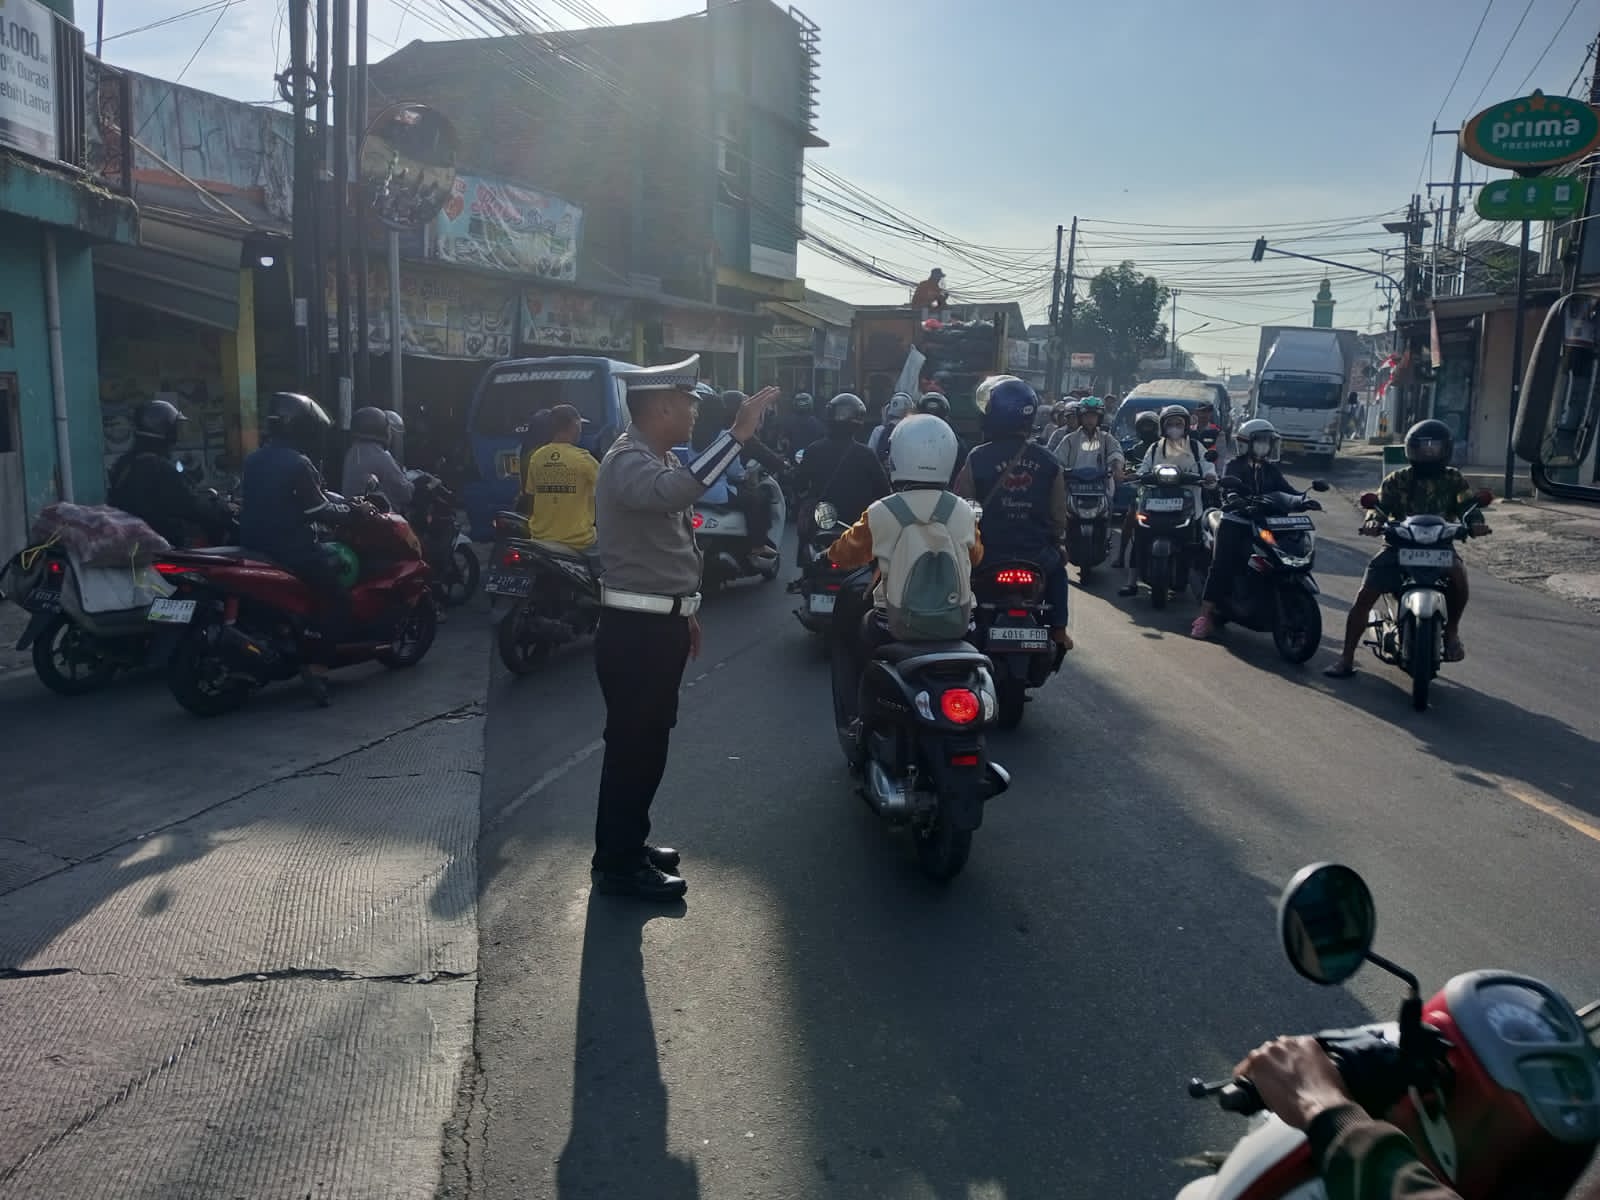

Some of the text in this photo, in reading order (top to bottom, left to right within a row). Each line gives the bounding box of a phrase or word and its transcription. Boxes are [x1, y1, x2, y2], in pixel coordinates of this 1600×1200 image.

[17, 60, 49, 89] Durasi
[23, 87, 51, 114] Lama
[1491, 118, 1581, 144] prima
